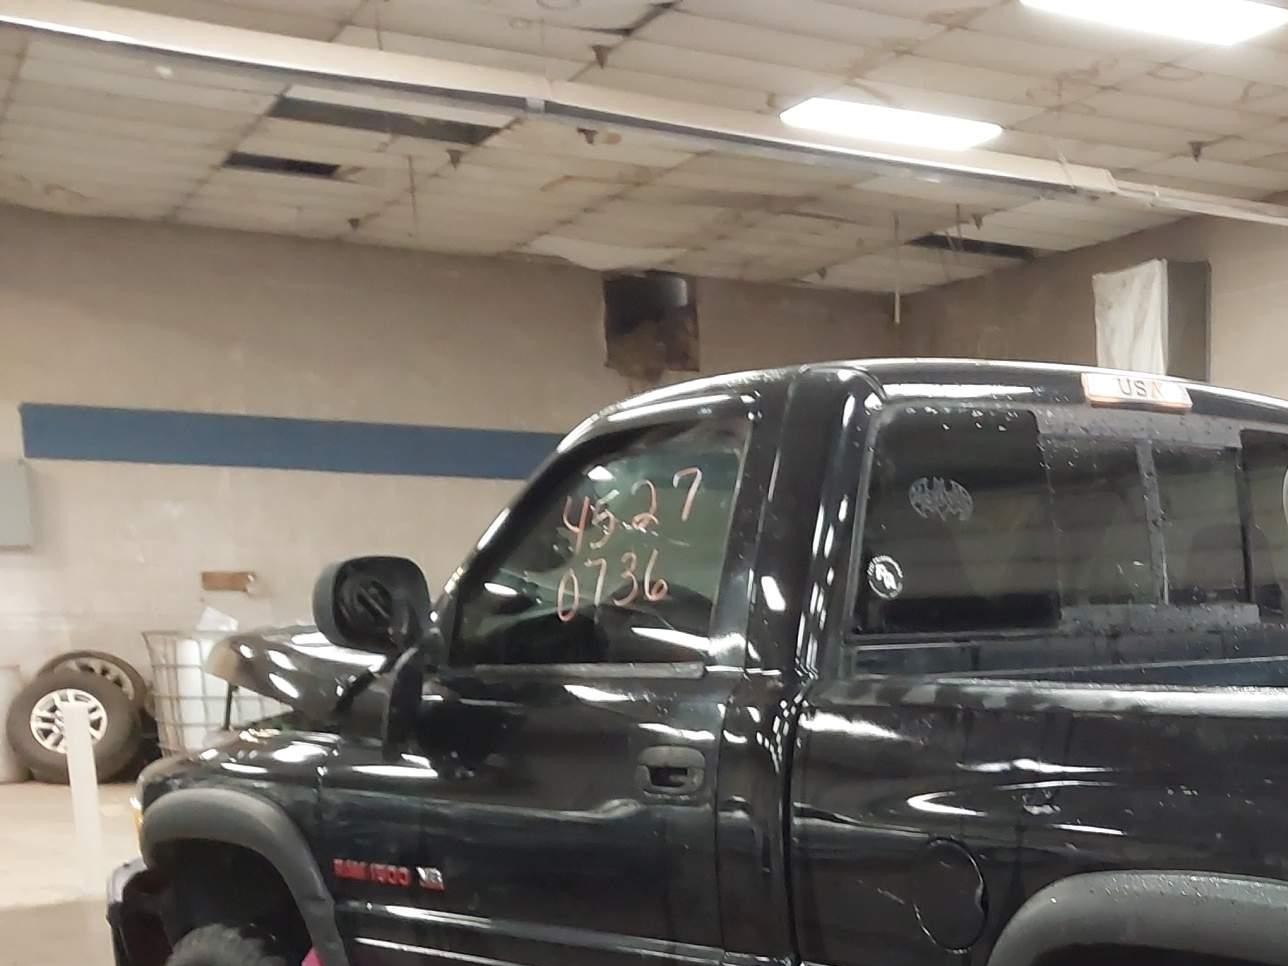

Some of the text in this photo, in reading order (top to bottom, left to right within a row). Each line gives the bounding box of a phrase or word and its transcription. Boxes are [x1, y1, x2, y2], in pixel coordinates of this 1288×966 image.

[1117, 377, 1167, 398] USA
[557, 549, 669, 624] 0736
[369, 862, 410, 887] 1500
